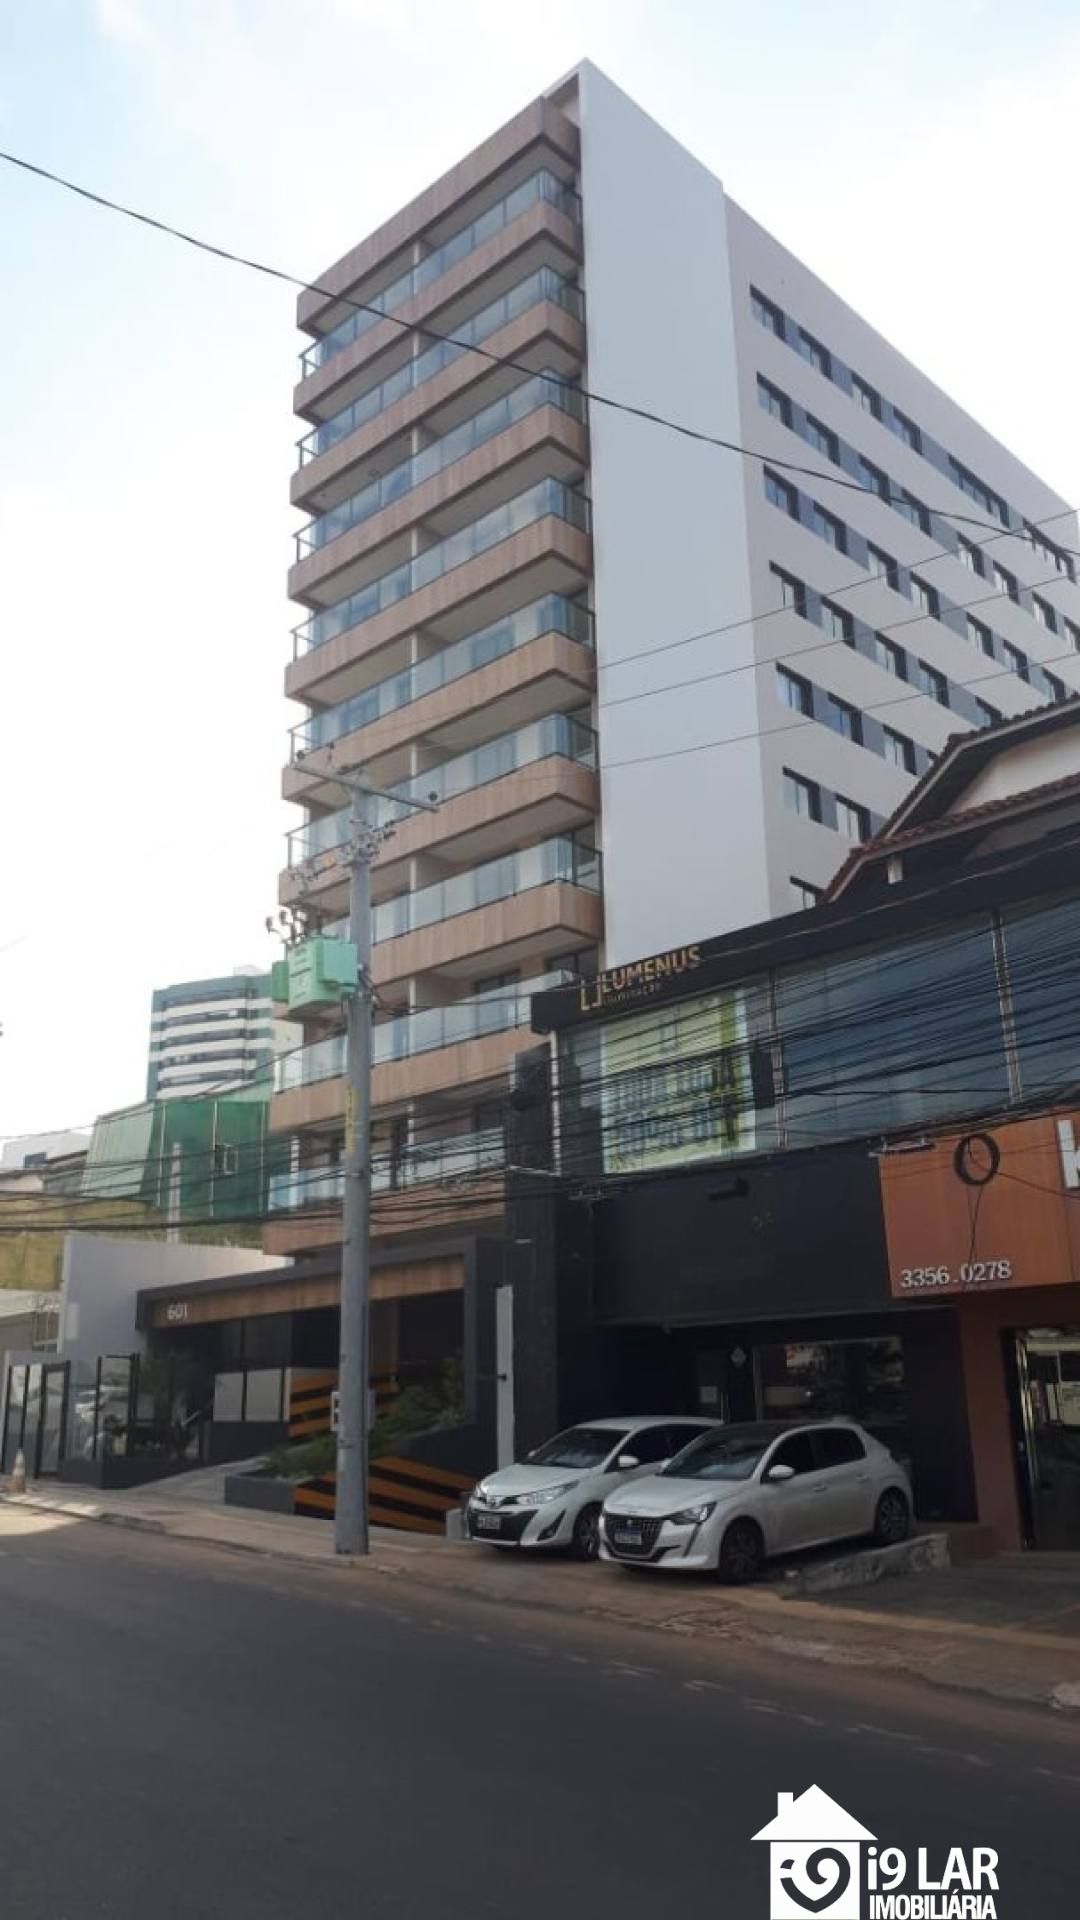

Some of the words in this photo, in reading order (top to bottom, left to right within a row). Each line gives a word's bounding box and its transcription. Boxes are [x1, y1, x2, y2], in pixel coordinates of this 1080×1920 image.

[602, 945, 700, 993] LUMENUS
[901, 1260, 1012, 1288] 3356.0278
[167, 1303, 188, 1320] 601
